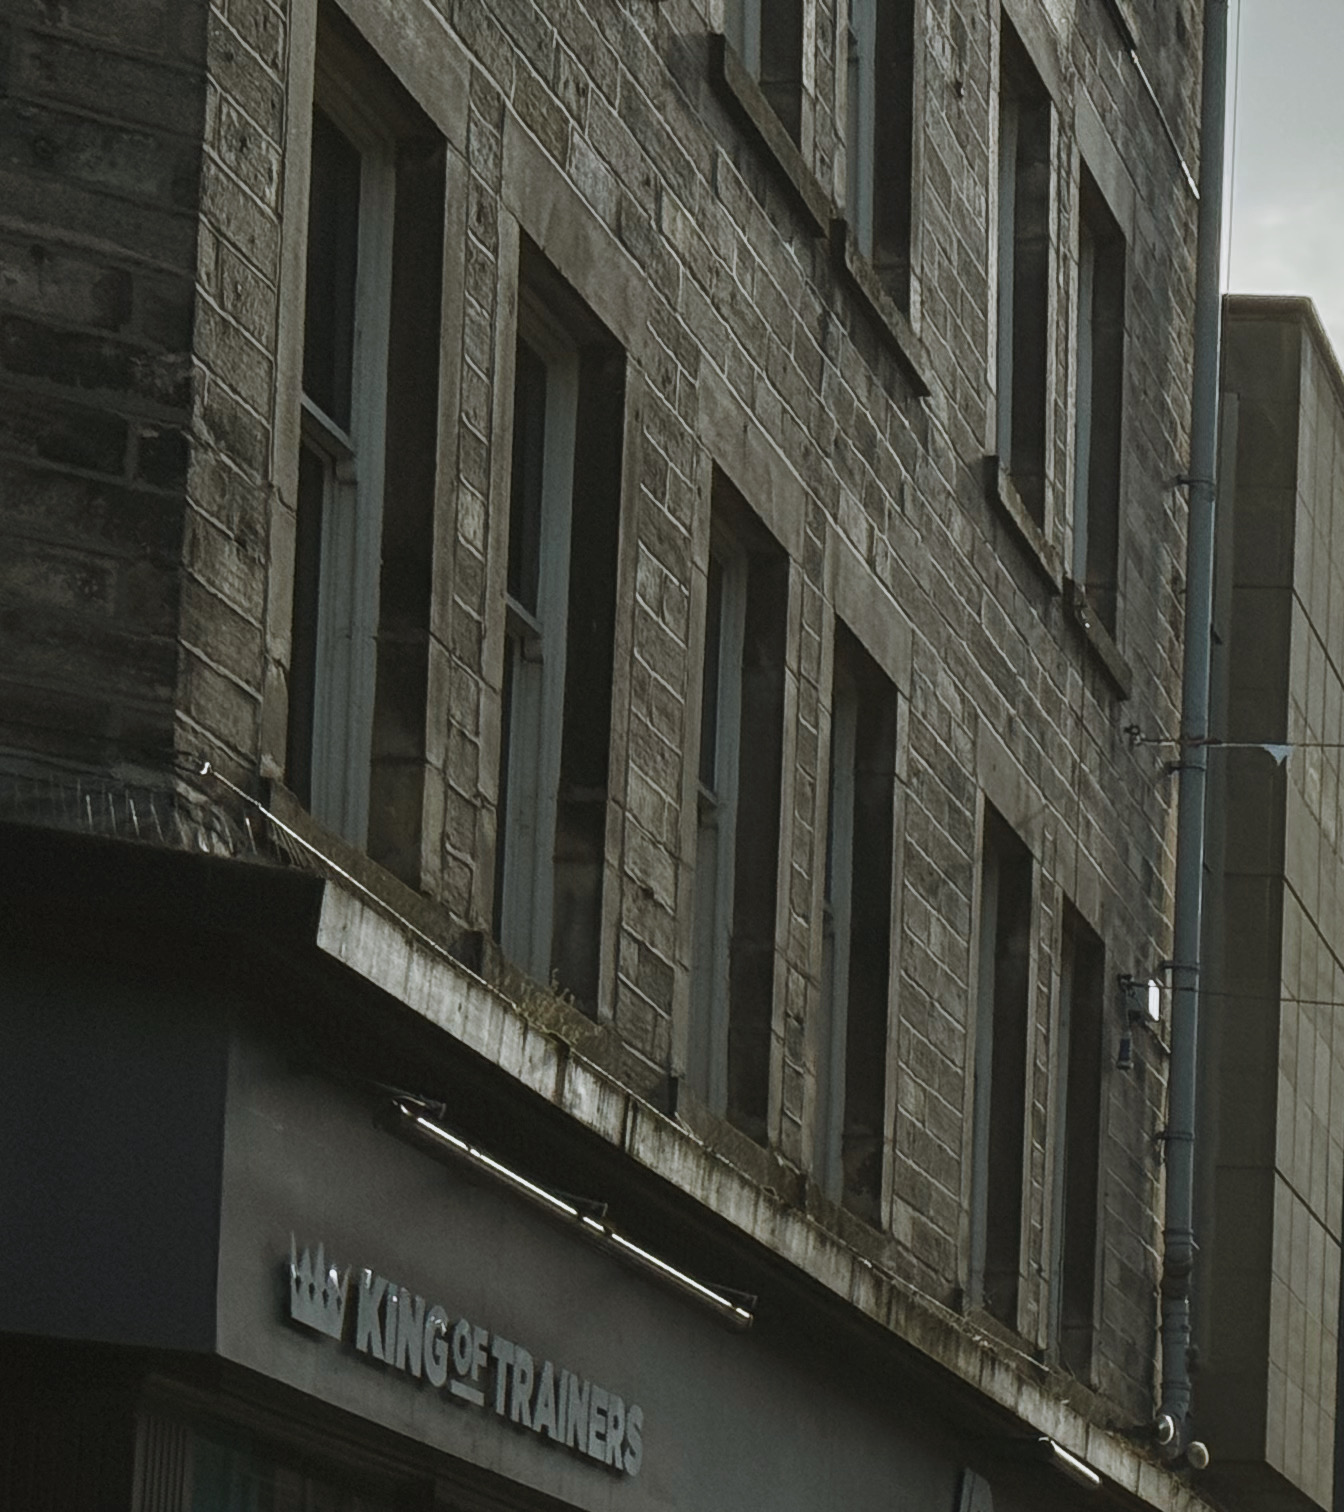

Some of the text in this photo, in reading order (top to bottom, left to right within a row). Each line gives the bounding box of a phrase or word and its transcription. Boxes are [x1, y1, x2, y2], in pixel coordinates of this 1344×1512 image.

[357, 1266, 645, 1477] KING OF TRAINERS
